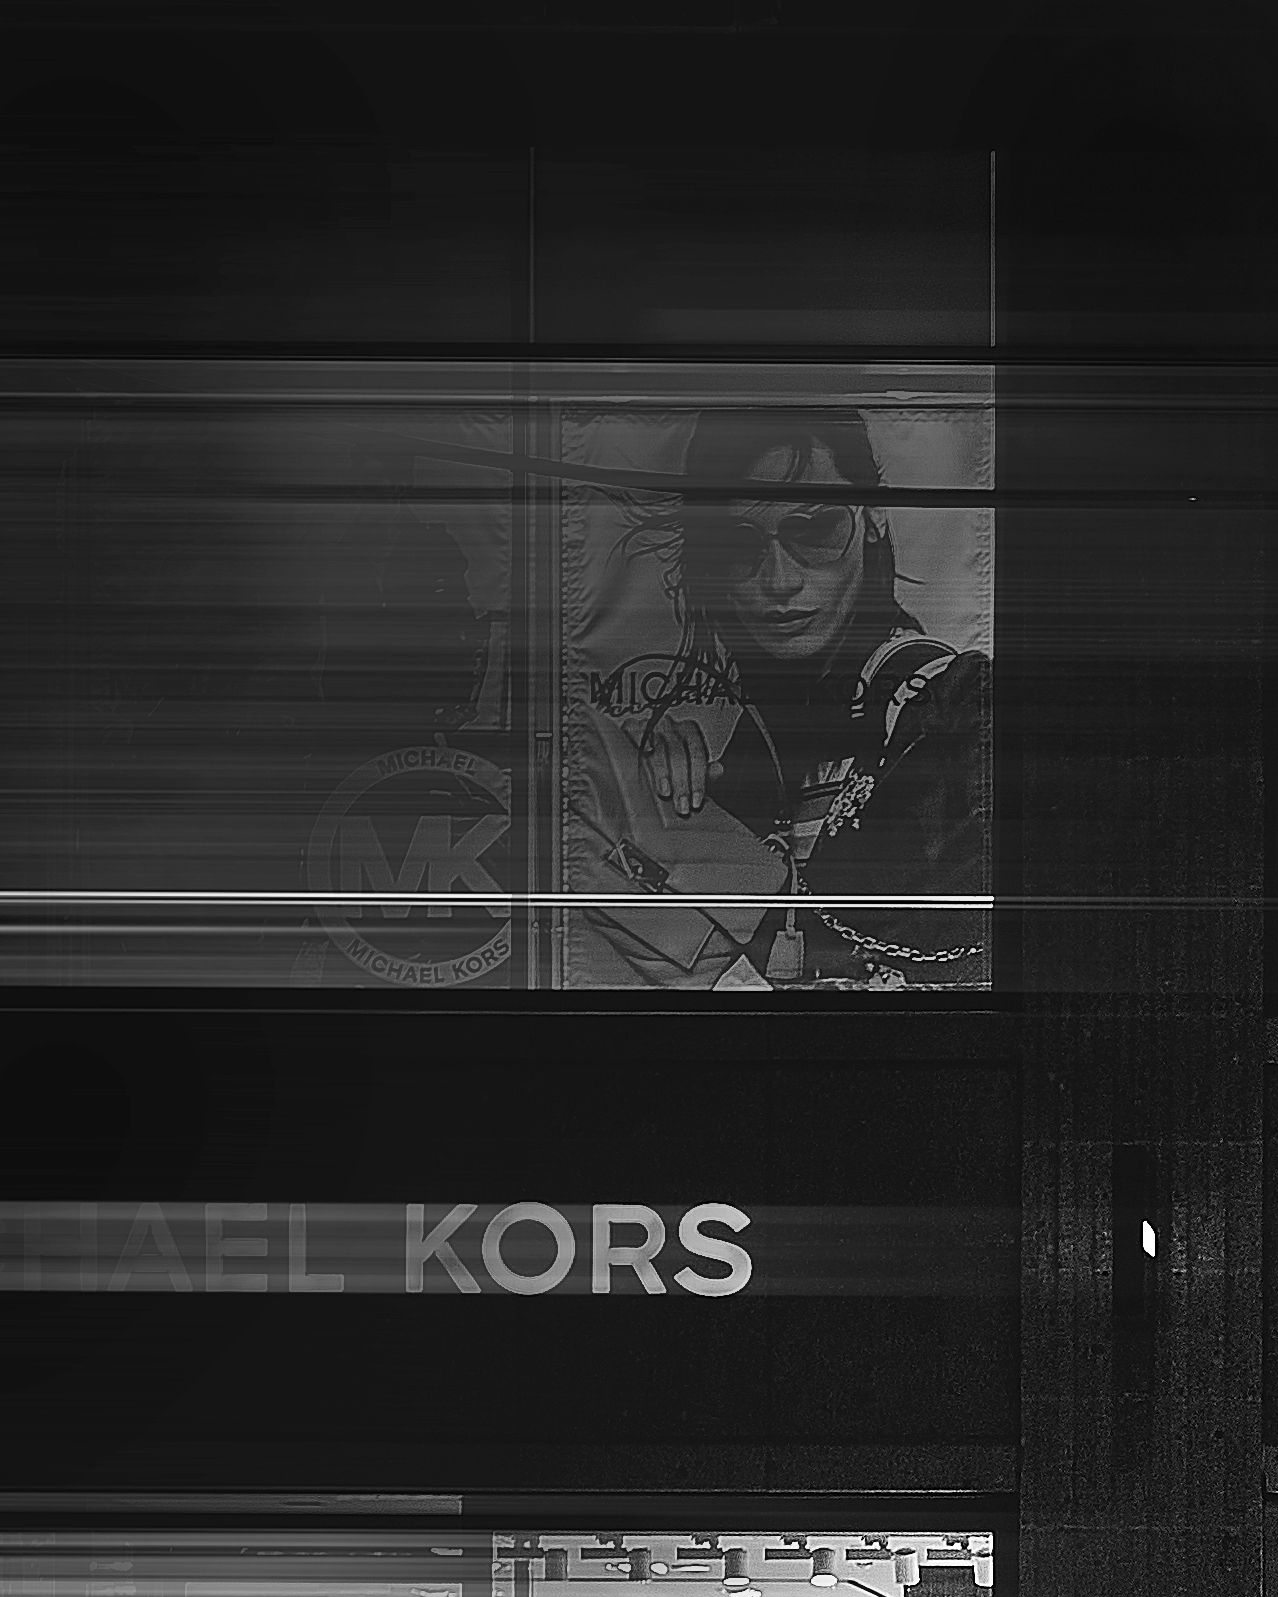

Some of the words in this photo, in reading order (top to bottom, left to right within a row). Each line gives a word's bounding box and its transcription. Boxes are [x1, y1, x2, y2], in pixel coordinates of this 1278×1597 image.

[376, 749, 477, 777] MICHAEL
[338, 814, 511, 918] MK
[347, 938, 445, 984] MICHAEL
[451, 938, 510, 979] KORS
[406, 1201, 752, 1298] KORS
